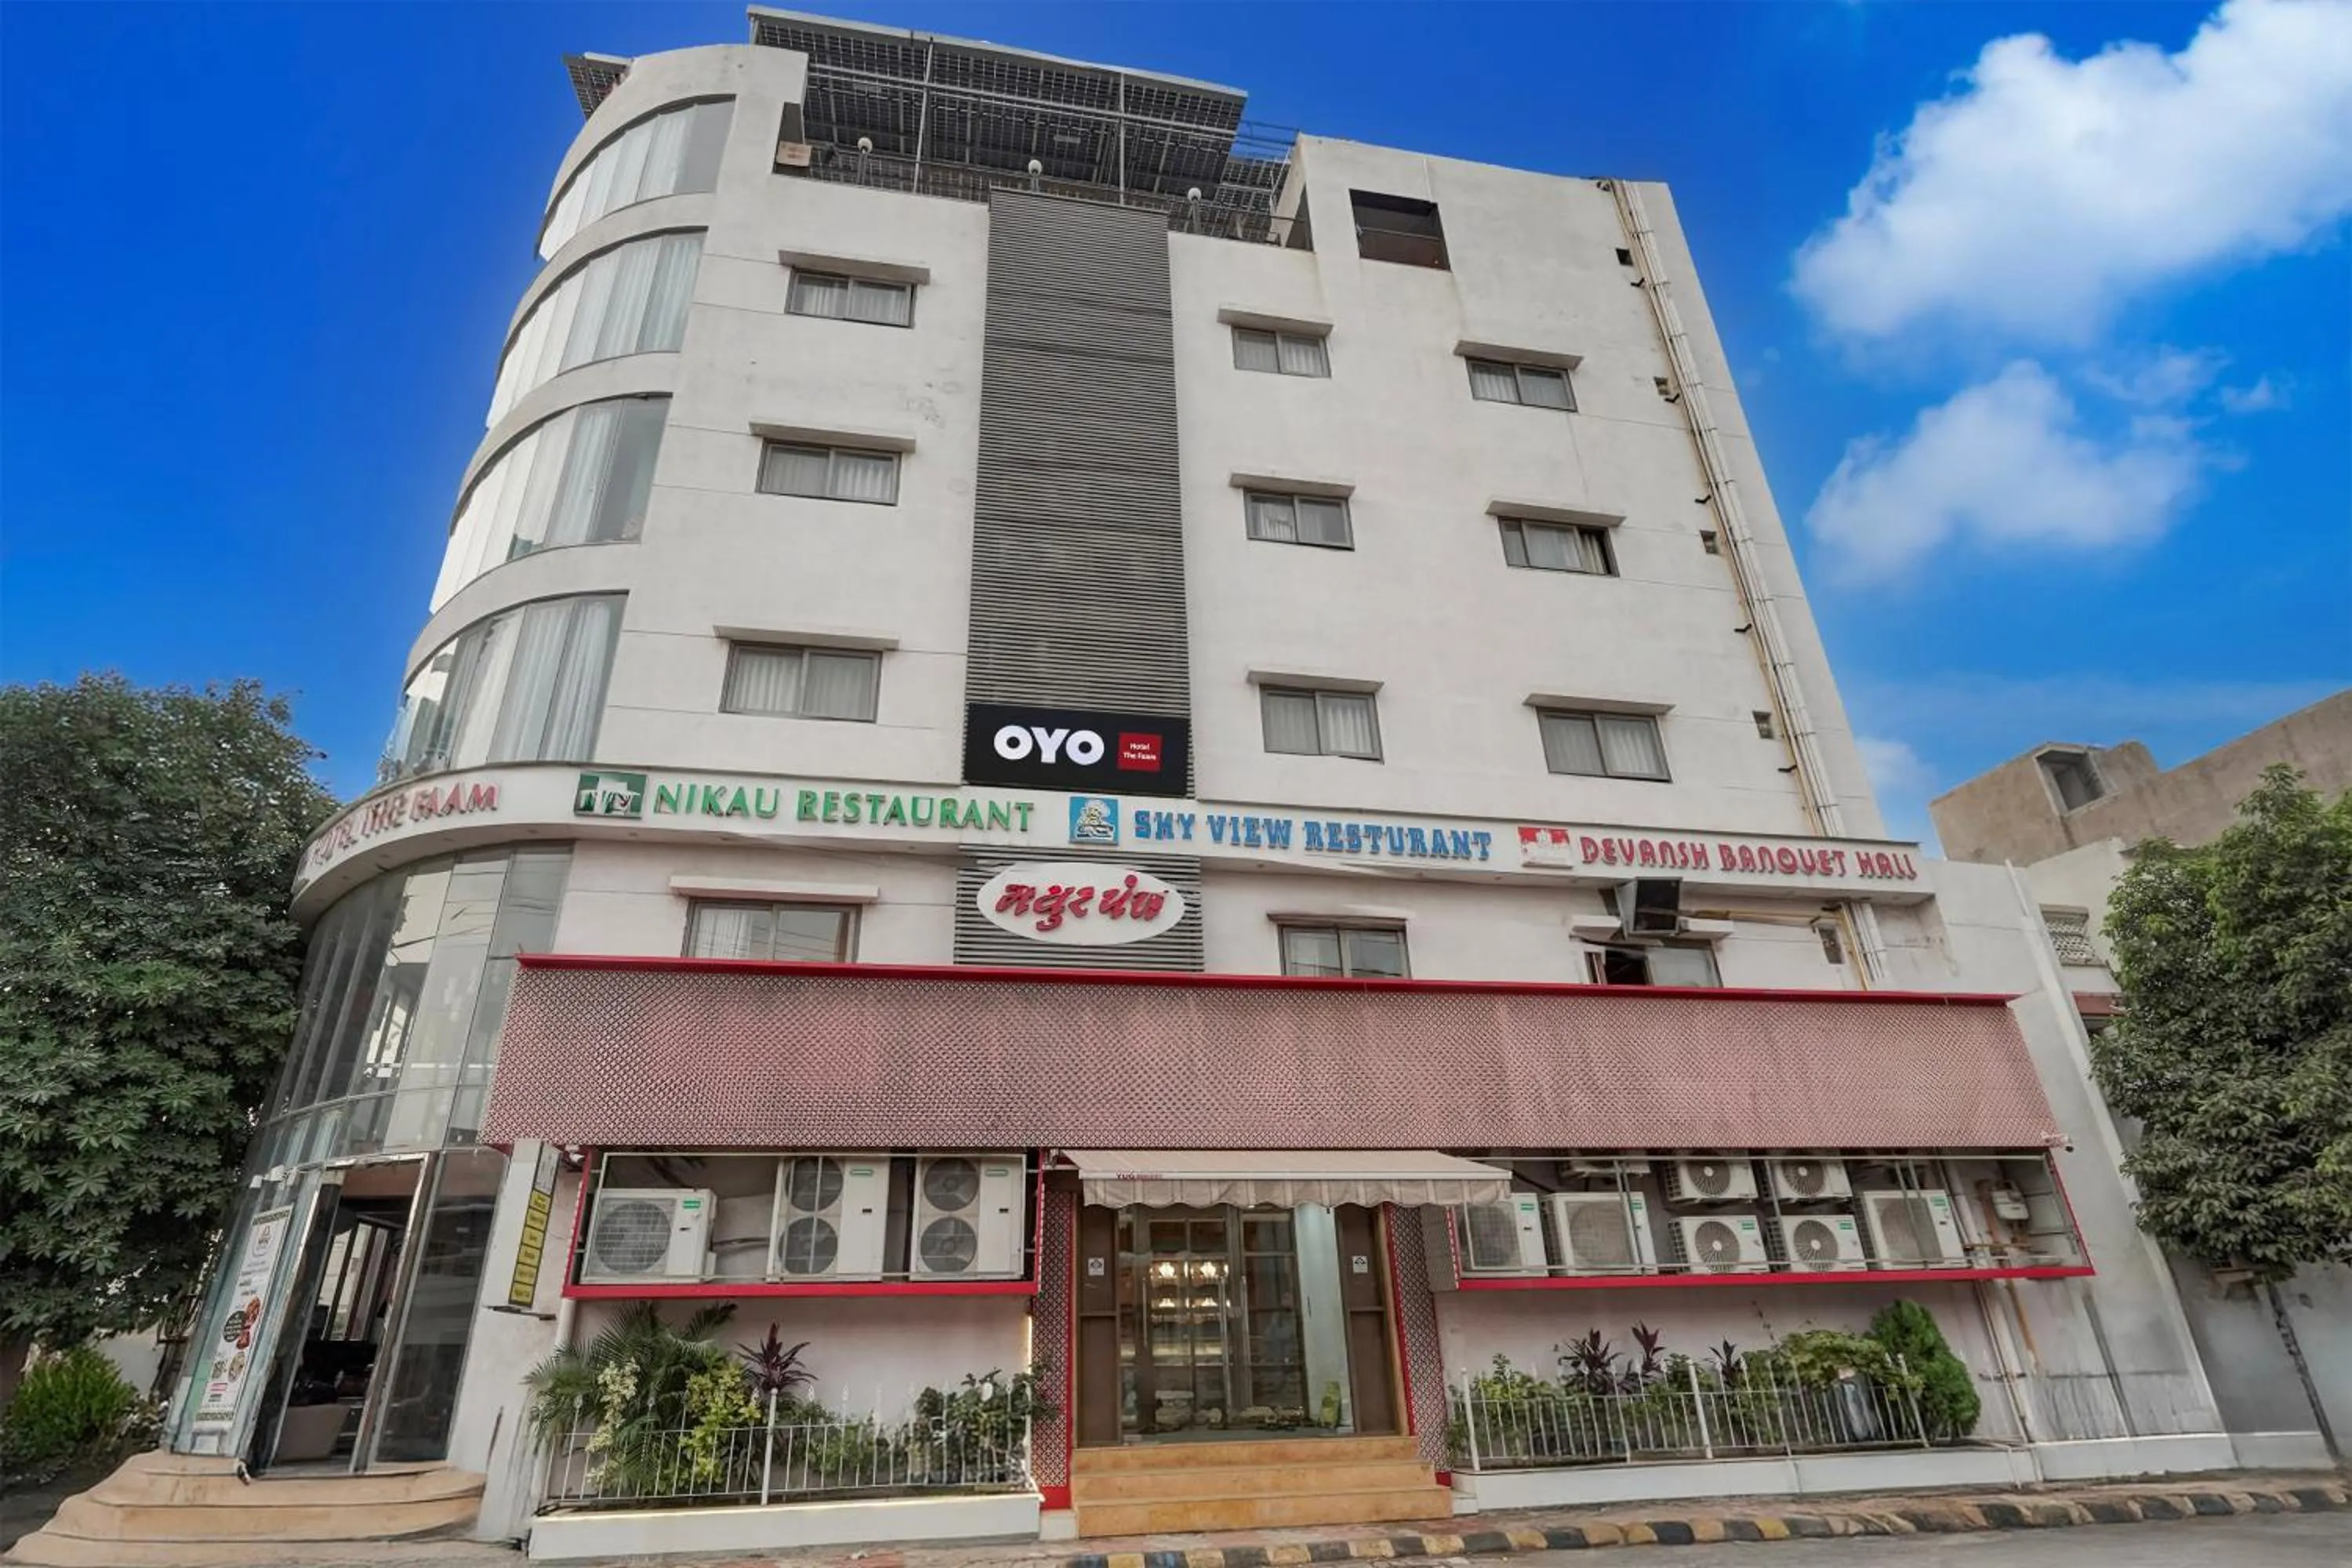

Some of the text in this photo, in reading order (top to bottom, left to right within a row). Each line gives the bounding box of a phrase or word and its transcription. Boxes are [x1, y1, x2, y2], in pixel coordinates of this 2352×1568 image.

[993, 724, 1105, 766] OYO
[653, 783, 1034, 832] NIKAU RESTAURANT
[1206, 815, 1293, 851] VIEW
[1304, 821, 1491, 862] RESTURANT
[1579, 836, 1918, 880] DEVANSH BANQUET HALL
